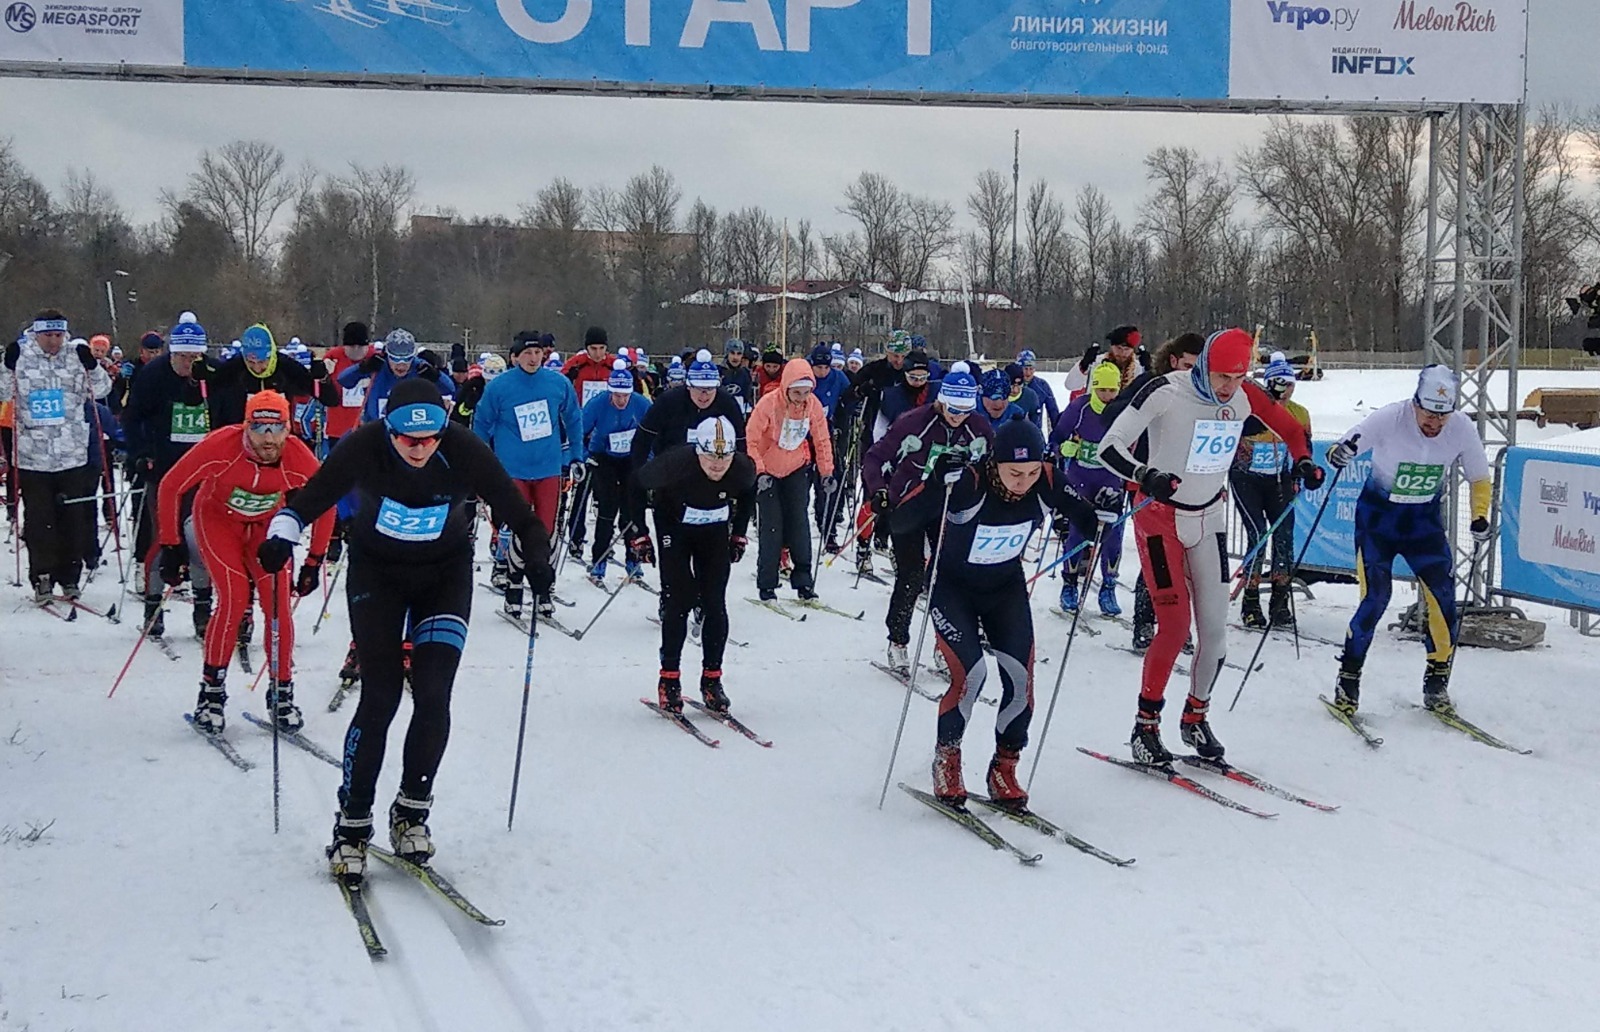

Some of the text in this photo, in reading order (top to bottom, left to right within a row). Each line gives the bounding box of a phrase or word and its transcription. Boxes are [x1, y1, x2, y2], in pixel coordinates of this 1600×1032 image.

[112, 6, 142, 14] ЦЕНТРЫ
[1267, 1, 1360, 32] Утро.ру
[1393, 1, 1497, 33] MelonRich
[42, 12, 141, 27] MEGASPORT
[1011, 15, 1168, 37] ЛИНИЯ ЖИЗНИ
[1010, 37, 1169, 56] благотворительный фонд
[1331, 46, 1382, 55] МЕДИАГРУППА
[1332, 55, 1416, 76] INFOX
[31, 398, 61, 415] 531
[175, 412, 206, 429] 114
[518, 410, 548, 429] 792
[612, 439, 631, 451] 75
[1195, 435, 1237, 455] 769
[1396, 473, 1438, 491] 025
[230, 496, 276, 510] 022
[383, 510, 438, 531] 521
[977, 533, 1024, 551] 770
[931, 606, 958, 636] CRAFT
